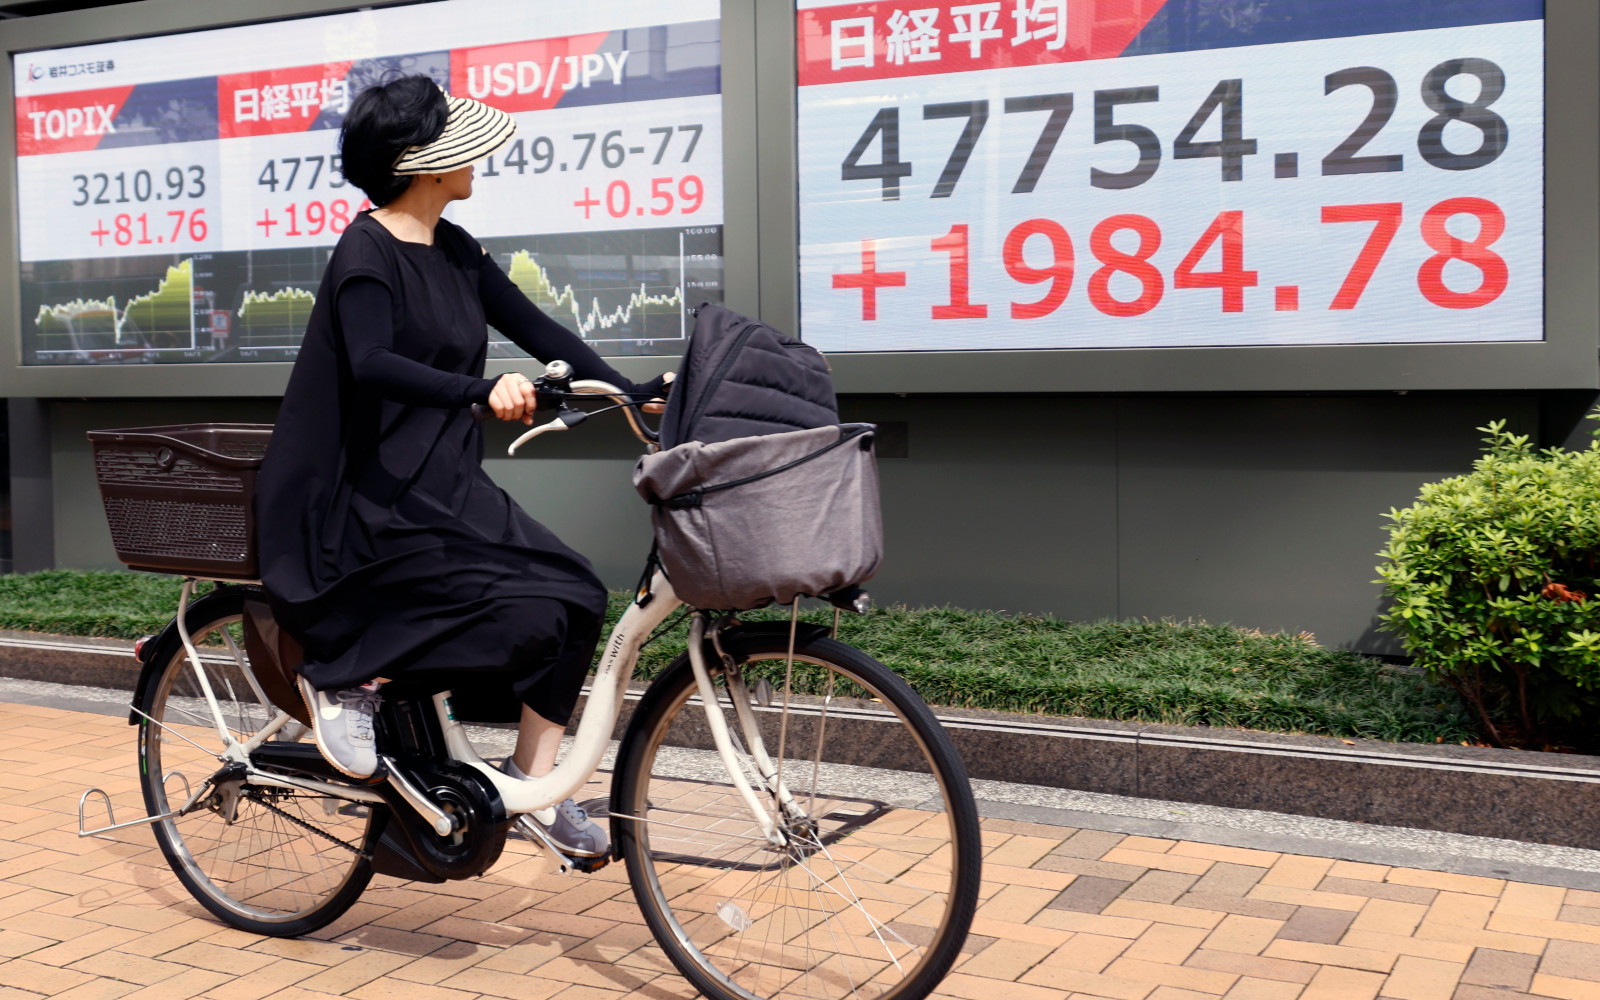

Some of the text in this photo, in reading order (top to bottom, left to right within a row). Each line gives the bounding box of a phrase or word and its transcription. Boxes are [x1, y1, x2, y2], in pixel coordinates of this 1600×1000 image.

[830, 0, 1068, 71] 日経平均
[467, 50, 630, 98] USD/JPY
[28, 104, 117, 140] TOPIX
[233, 77, 350, 123] 日経平均
[481, 123, 703, 178] 149.76-77
[841, 57, 1509, 202] 47754.28
[72, 165, 206, 207] 3210.93
[573, 174, 704, 219] +0.59
[90, 208, 208, 247] +81.76
[832, 196, 1509, 321] +1984.78
